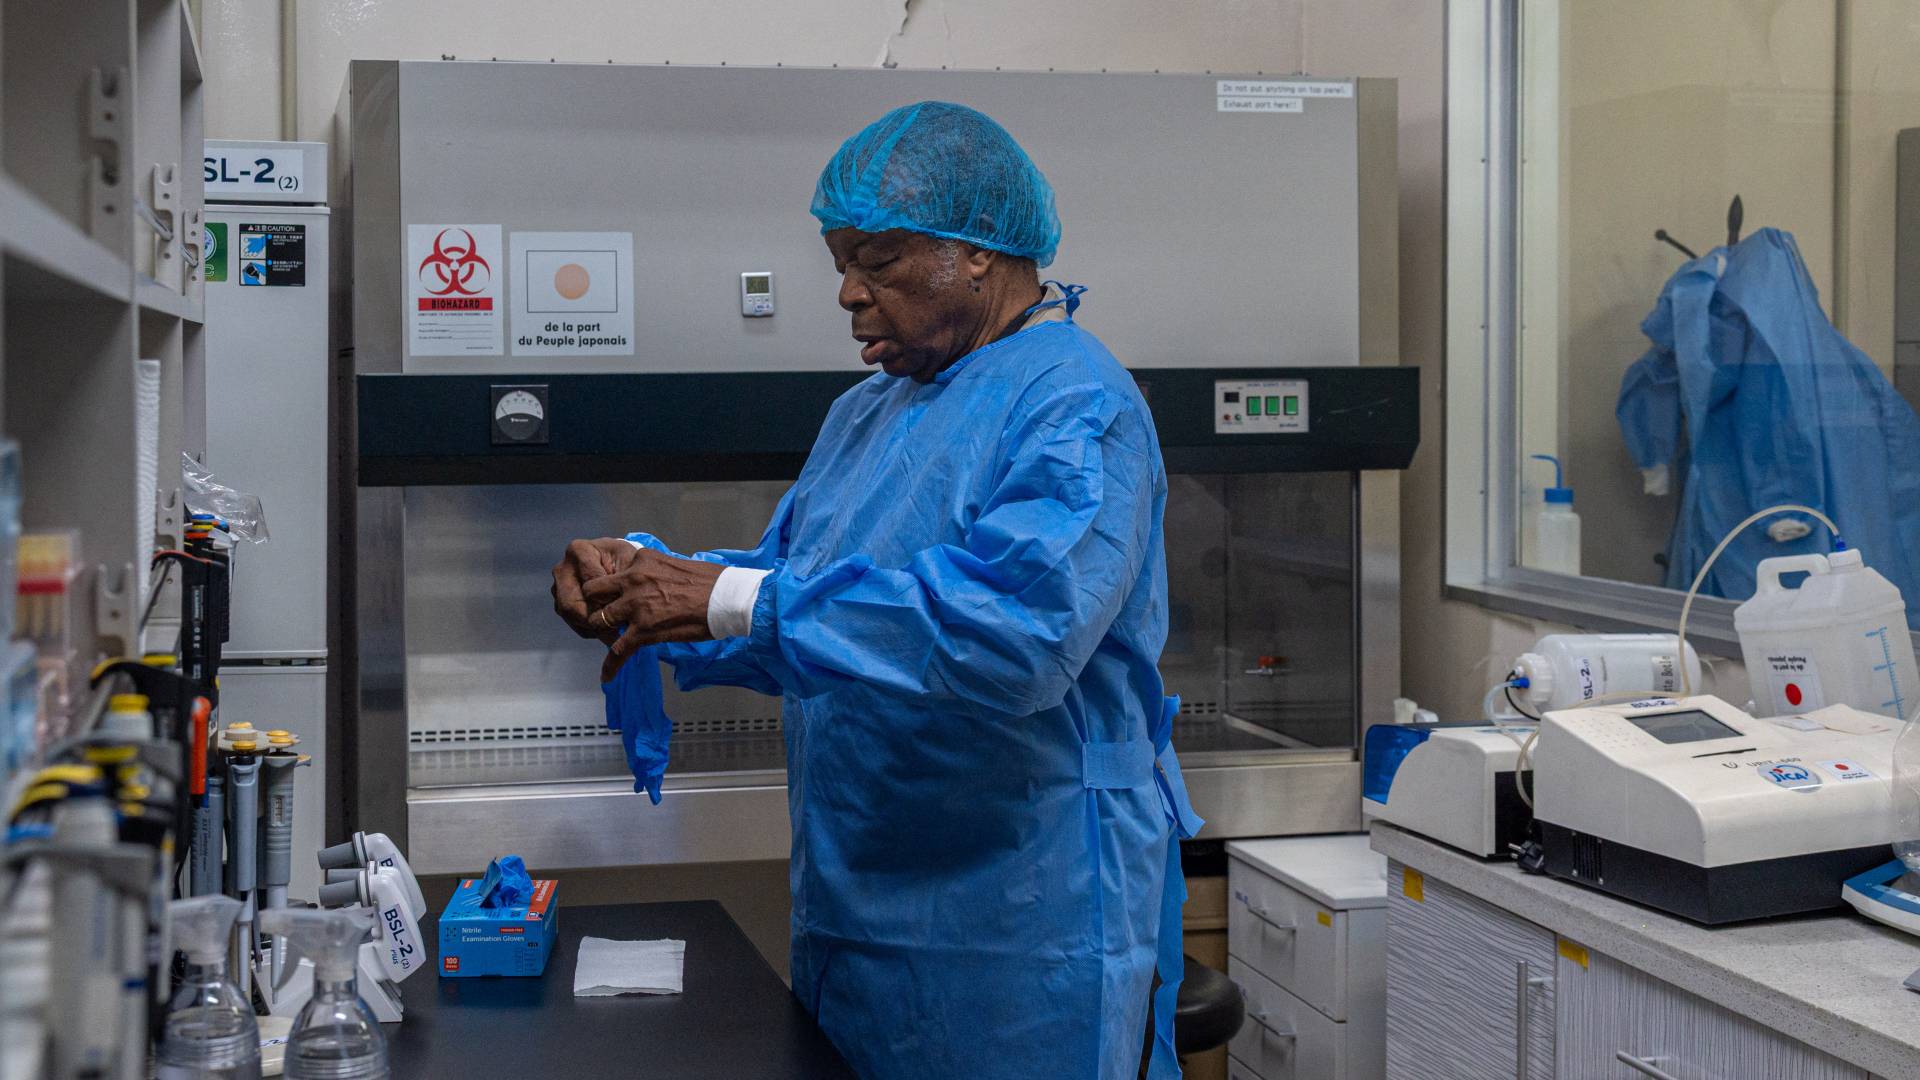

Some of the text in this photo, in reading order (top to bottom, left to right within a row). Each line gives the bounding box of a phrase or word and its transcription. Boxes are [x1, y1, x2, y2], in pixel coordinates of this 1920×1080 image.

[1235, 84, 1247, 93] not
[204, 158, 275, 183] SL-2
[431, 299, 480, 309] BIOHAZARD
[545, 322, 601, 334] de la part
[518, 336, 627, 347] du Peuple japonais
[384, 908, 413, 957] BSL-2
